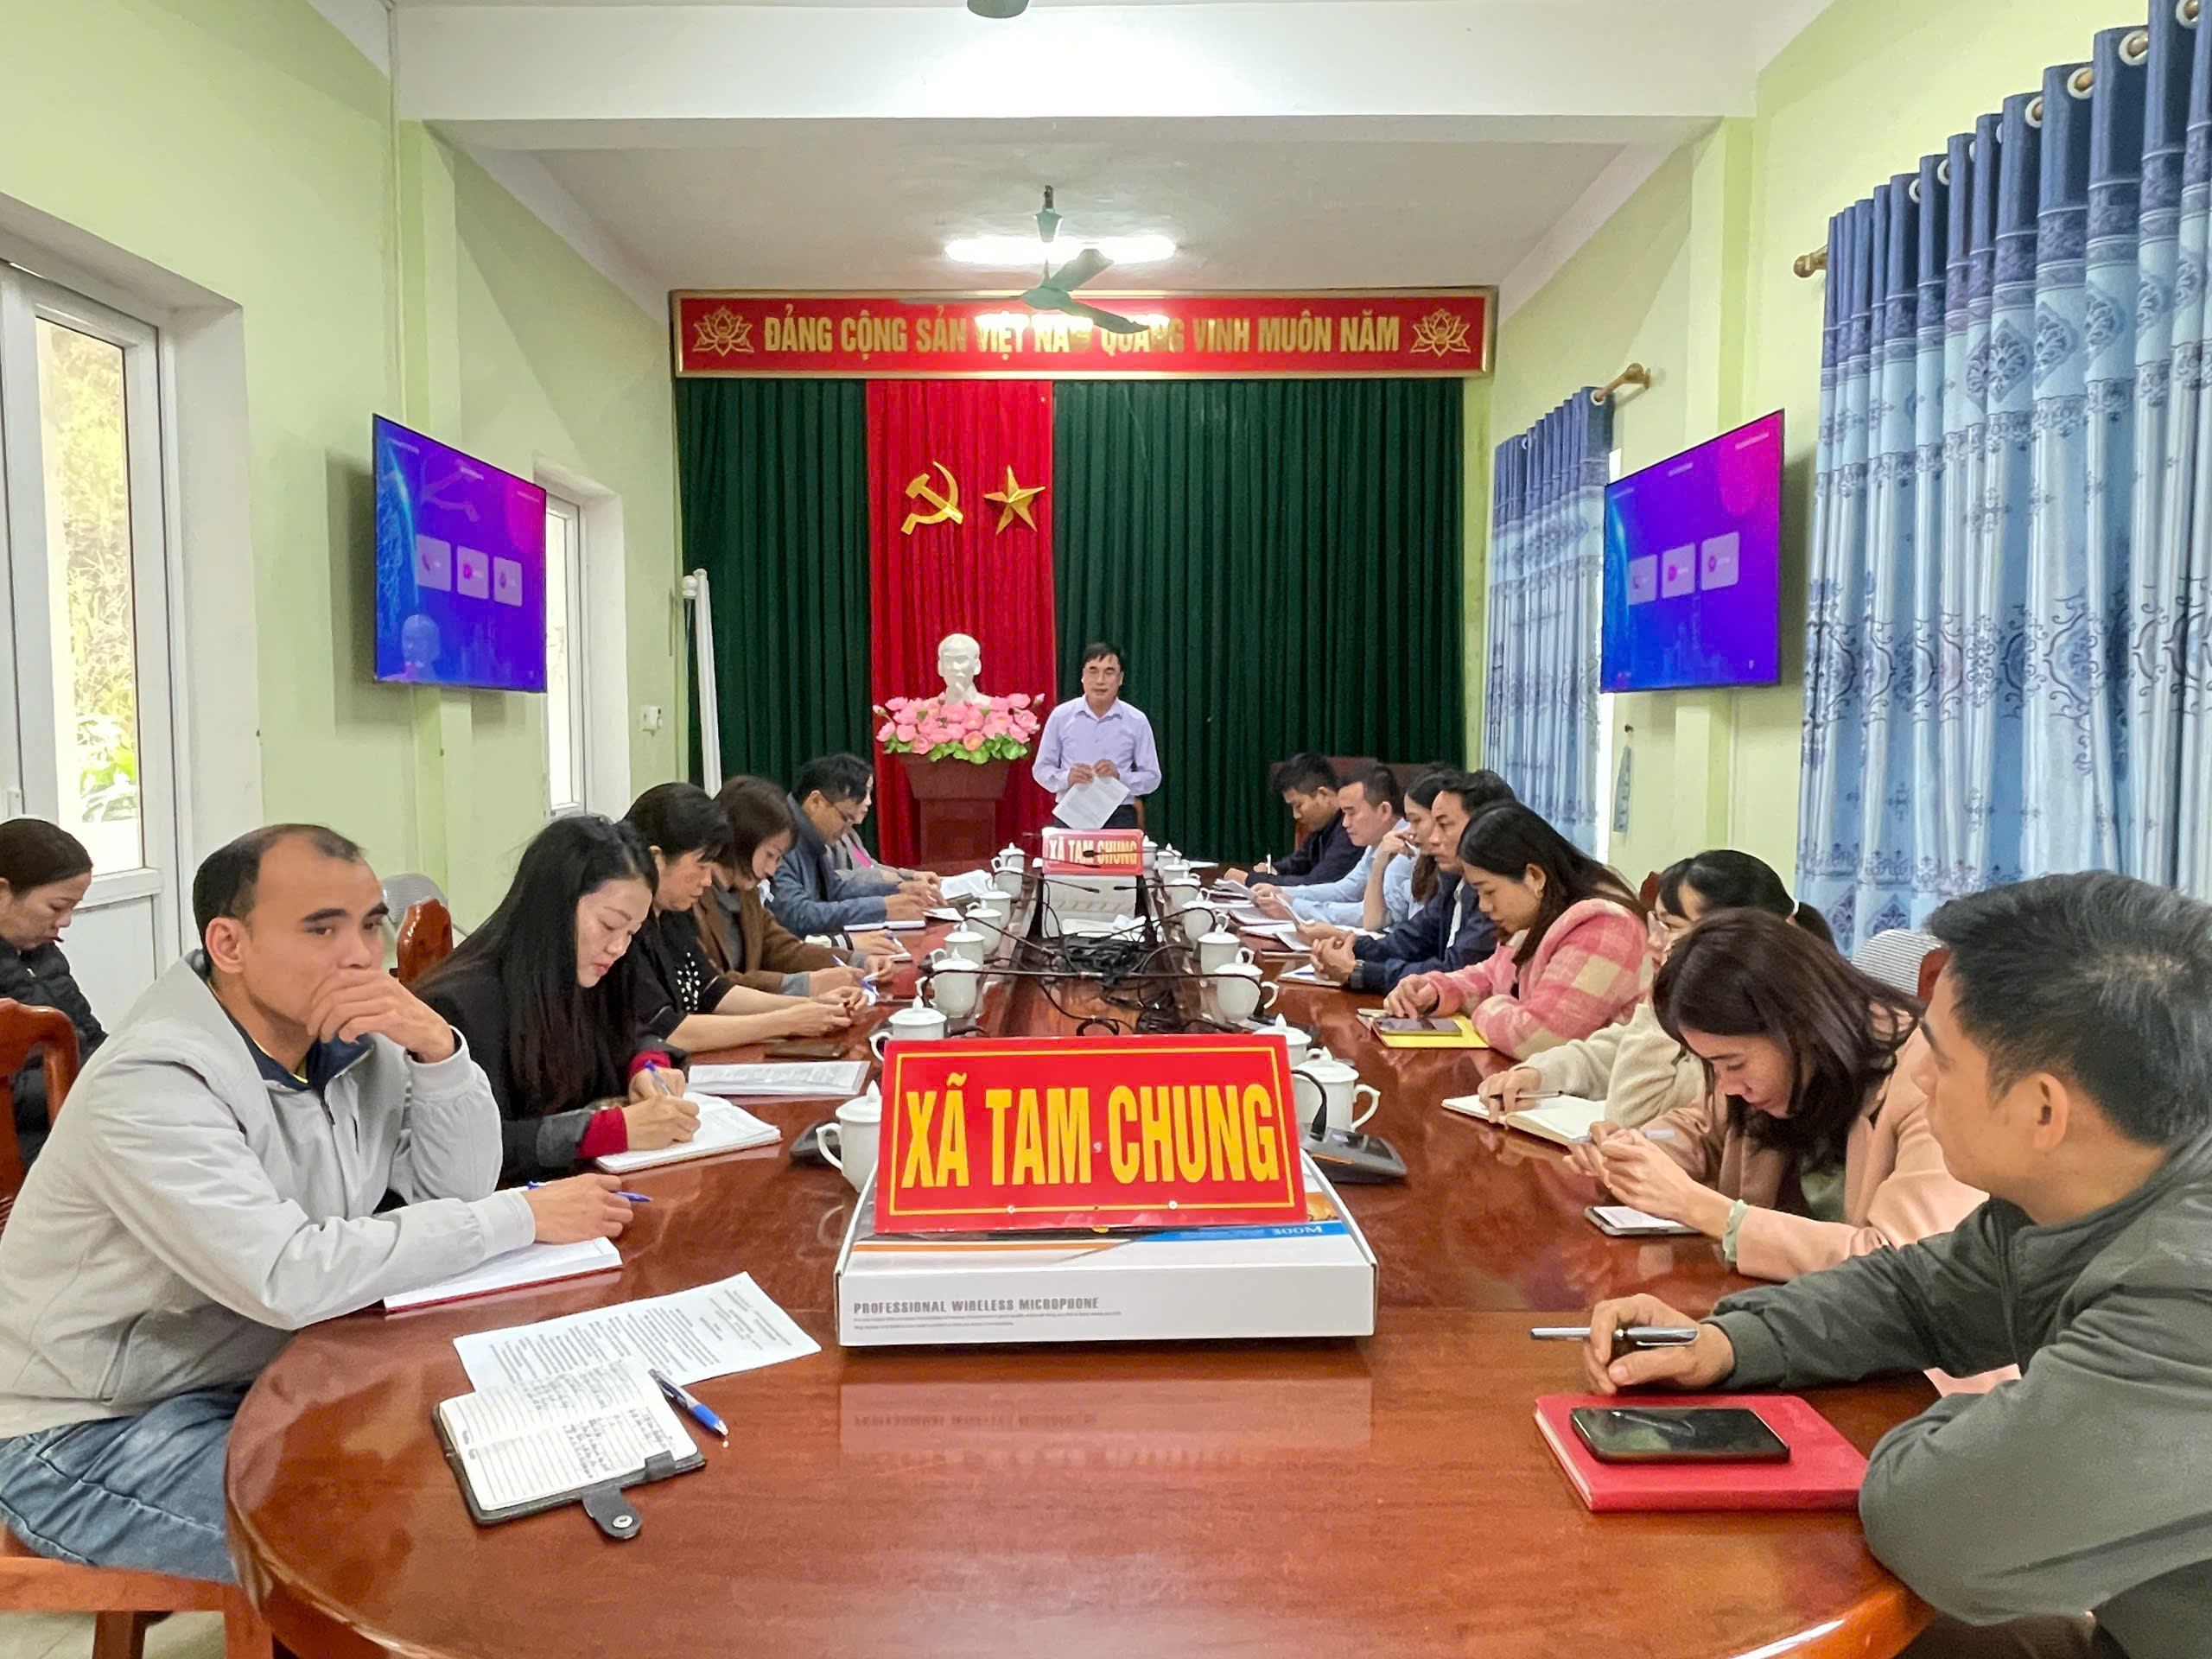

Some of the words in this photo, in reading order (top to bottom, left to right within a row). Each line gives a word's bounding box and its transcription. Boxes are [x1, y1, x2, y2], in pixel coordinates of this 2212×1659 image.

[765, 303, 832, 352] ĐẢNG
[841, 309, 907, 360] CỘNG
[916, 304, 967, 352] SẢN
[975, 311, 1029, 360] VIỆT
[1033, 315, 1093, 353] NA
[1193, 318, 1249, 352] VINH
[1258, 309, 1332, 352] MUÔN
[1340, 308, 1400, 352] NĂM
[1097, 840, 1137, 864] CHUNG
[900, 1072, 969, 1189] XÃ
[986, 1087, 1092, 1185] TAM
[1107, 1084, 1281, 1185] CHUNG
[854, 1300, 947, 1314] PROFESSIONAL
[951, 1299, 1014, 1312] WIRELESS
[1019, 1297, 1100, 1310] MICROPHONE
